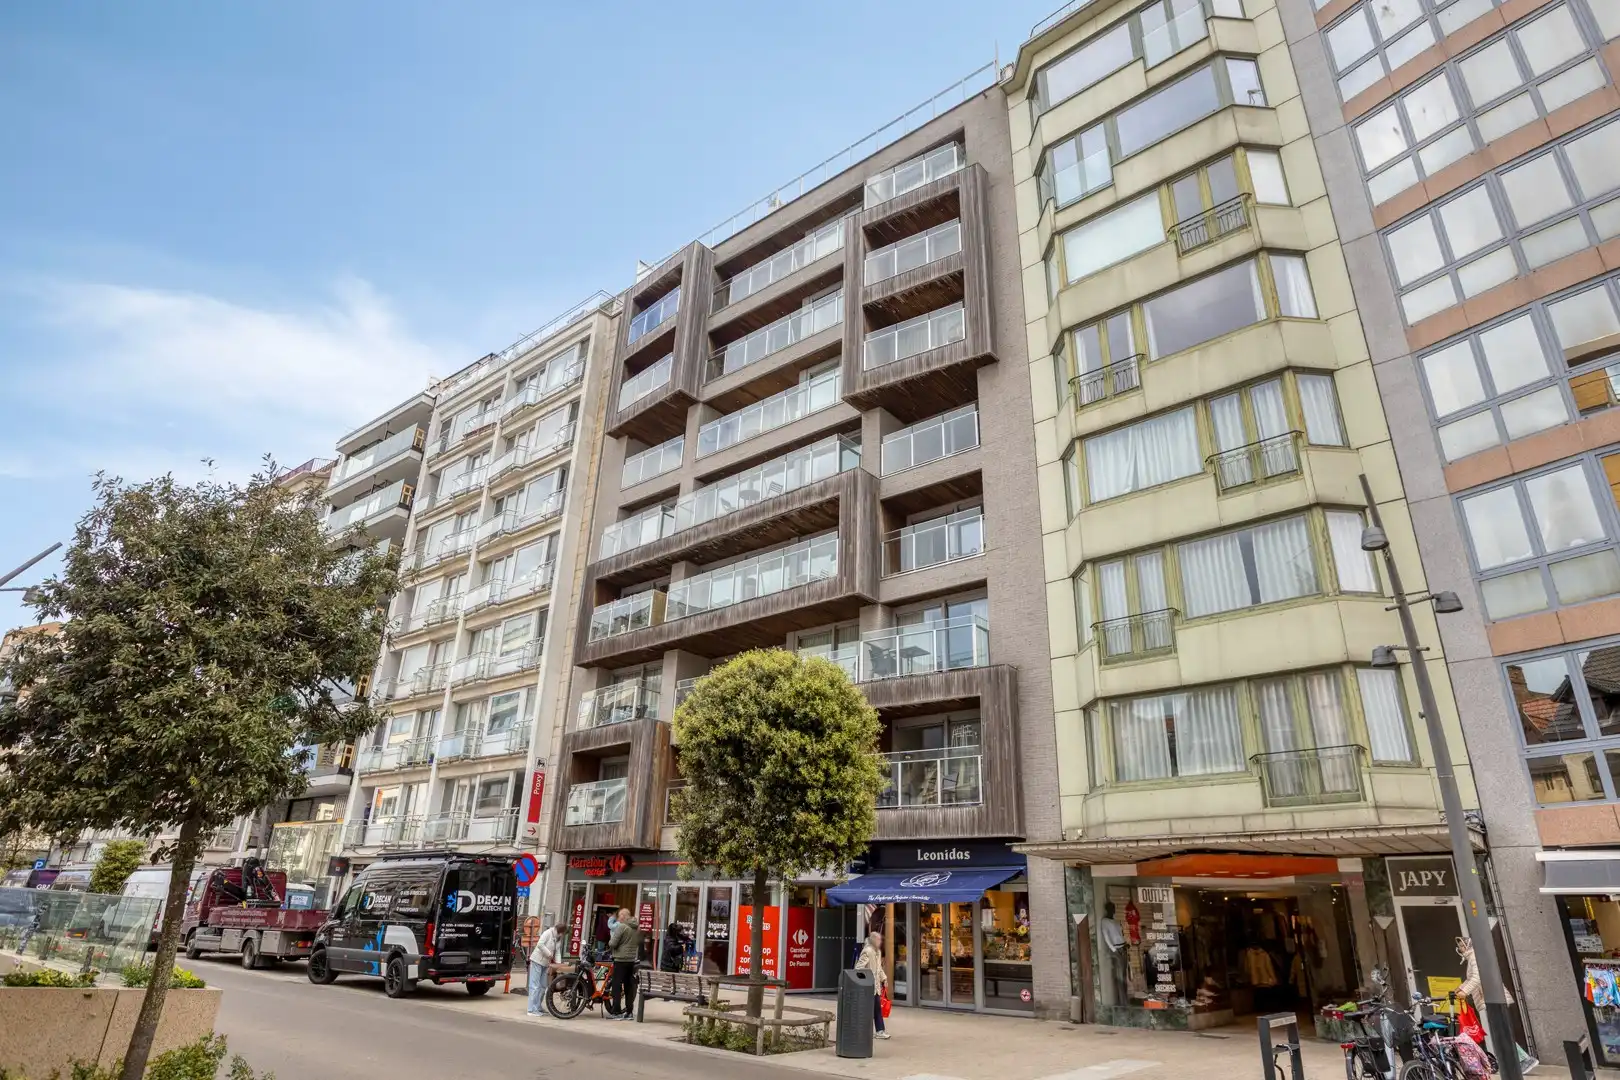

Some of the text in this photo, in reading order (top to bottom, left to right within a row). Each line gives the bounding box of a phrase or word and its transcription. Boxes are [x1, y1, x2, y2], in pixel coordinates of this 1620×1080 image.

[533, 774, 542, 795] Proxy
[917, 848, 970, 861] Leonidas
[1399, 870, 1446, 891] JAPY
[477, 895, 512, 905] DECAN
[1141, 888, 1170, 903] OUTLET
[708, 921, 727, 930] Ingang
[763, 947, 772, 955] op
